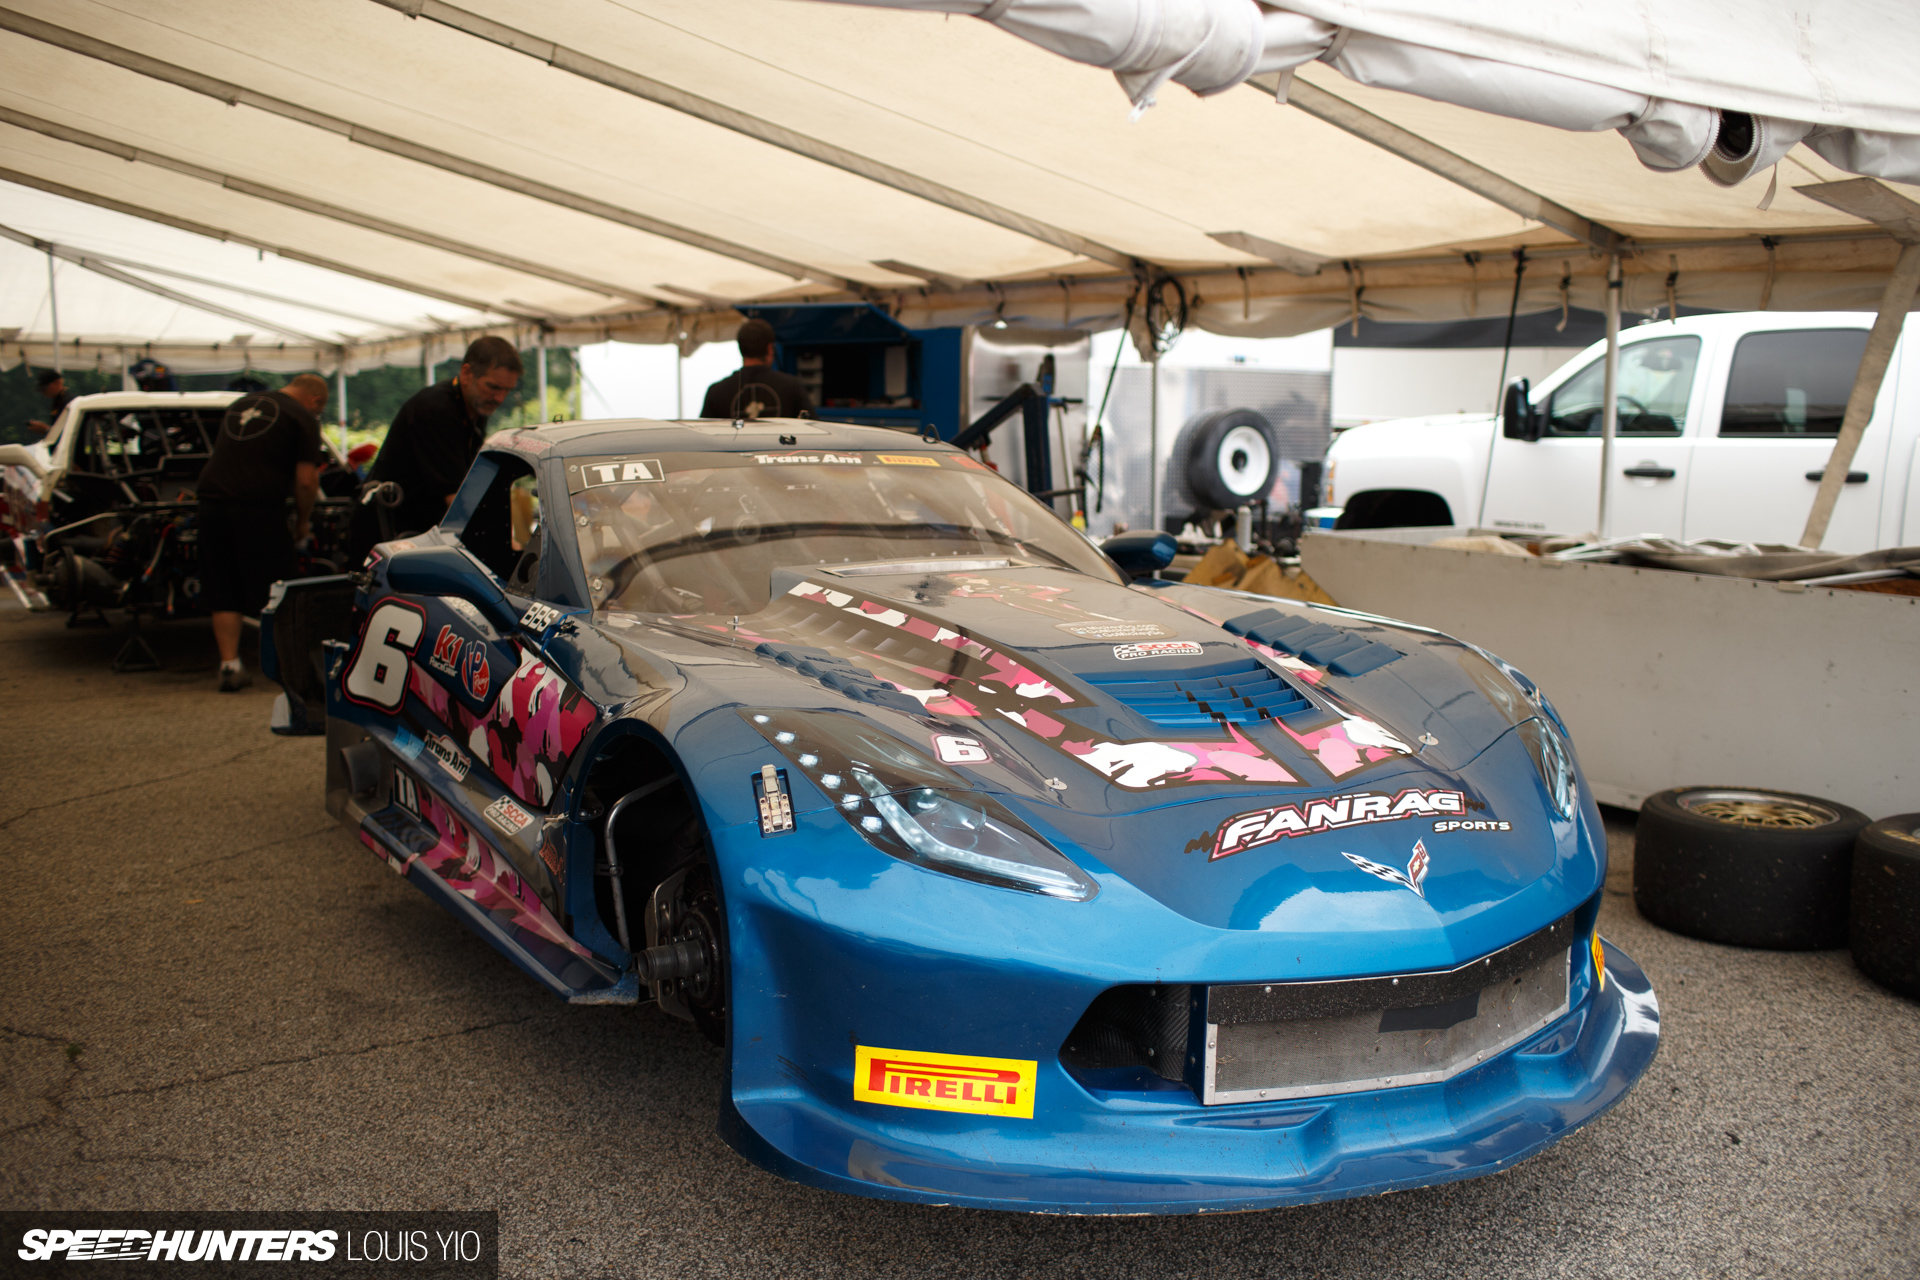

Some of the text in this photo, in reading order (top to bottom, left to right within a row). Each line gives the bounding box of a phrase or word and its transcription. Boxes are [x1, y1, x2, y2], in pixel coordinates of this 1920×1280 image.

[592, 462, 654, 482] TA
[754, 453, 862, 464] Trans Am
[519, 602, 559, 632] BBS
[345, 600, 426, 711] 6
[433, 624, 464, 669] K1
[1121, 651, 1148, 659] PRO
[425, 732, 451, 764] Trans
[450, 754, 469, 777] Am
[934, 734, 990, 764] 6
[396, 767, 419, 815] TA
[486, 806, 520, 833] PRO RACING
[503, 804, 529, 827] SCCA
[1217, 789, 1464, 853] FANRAG
[1434, 821, 1511, 832] SPORTS
[868, 1058, 1020, 1105] PIRELLI
